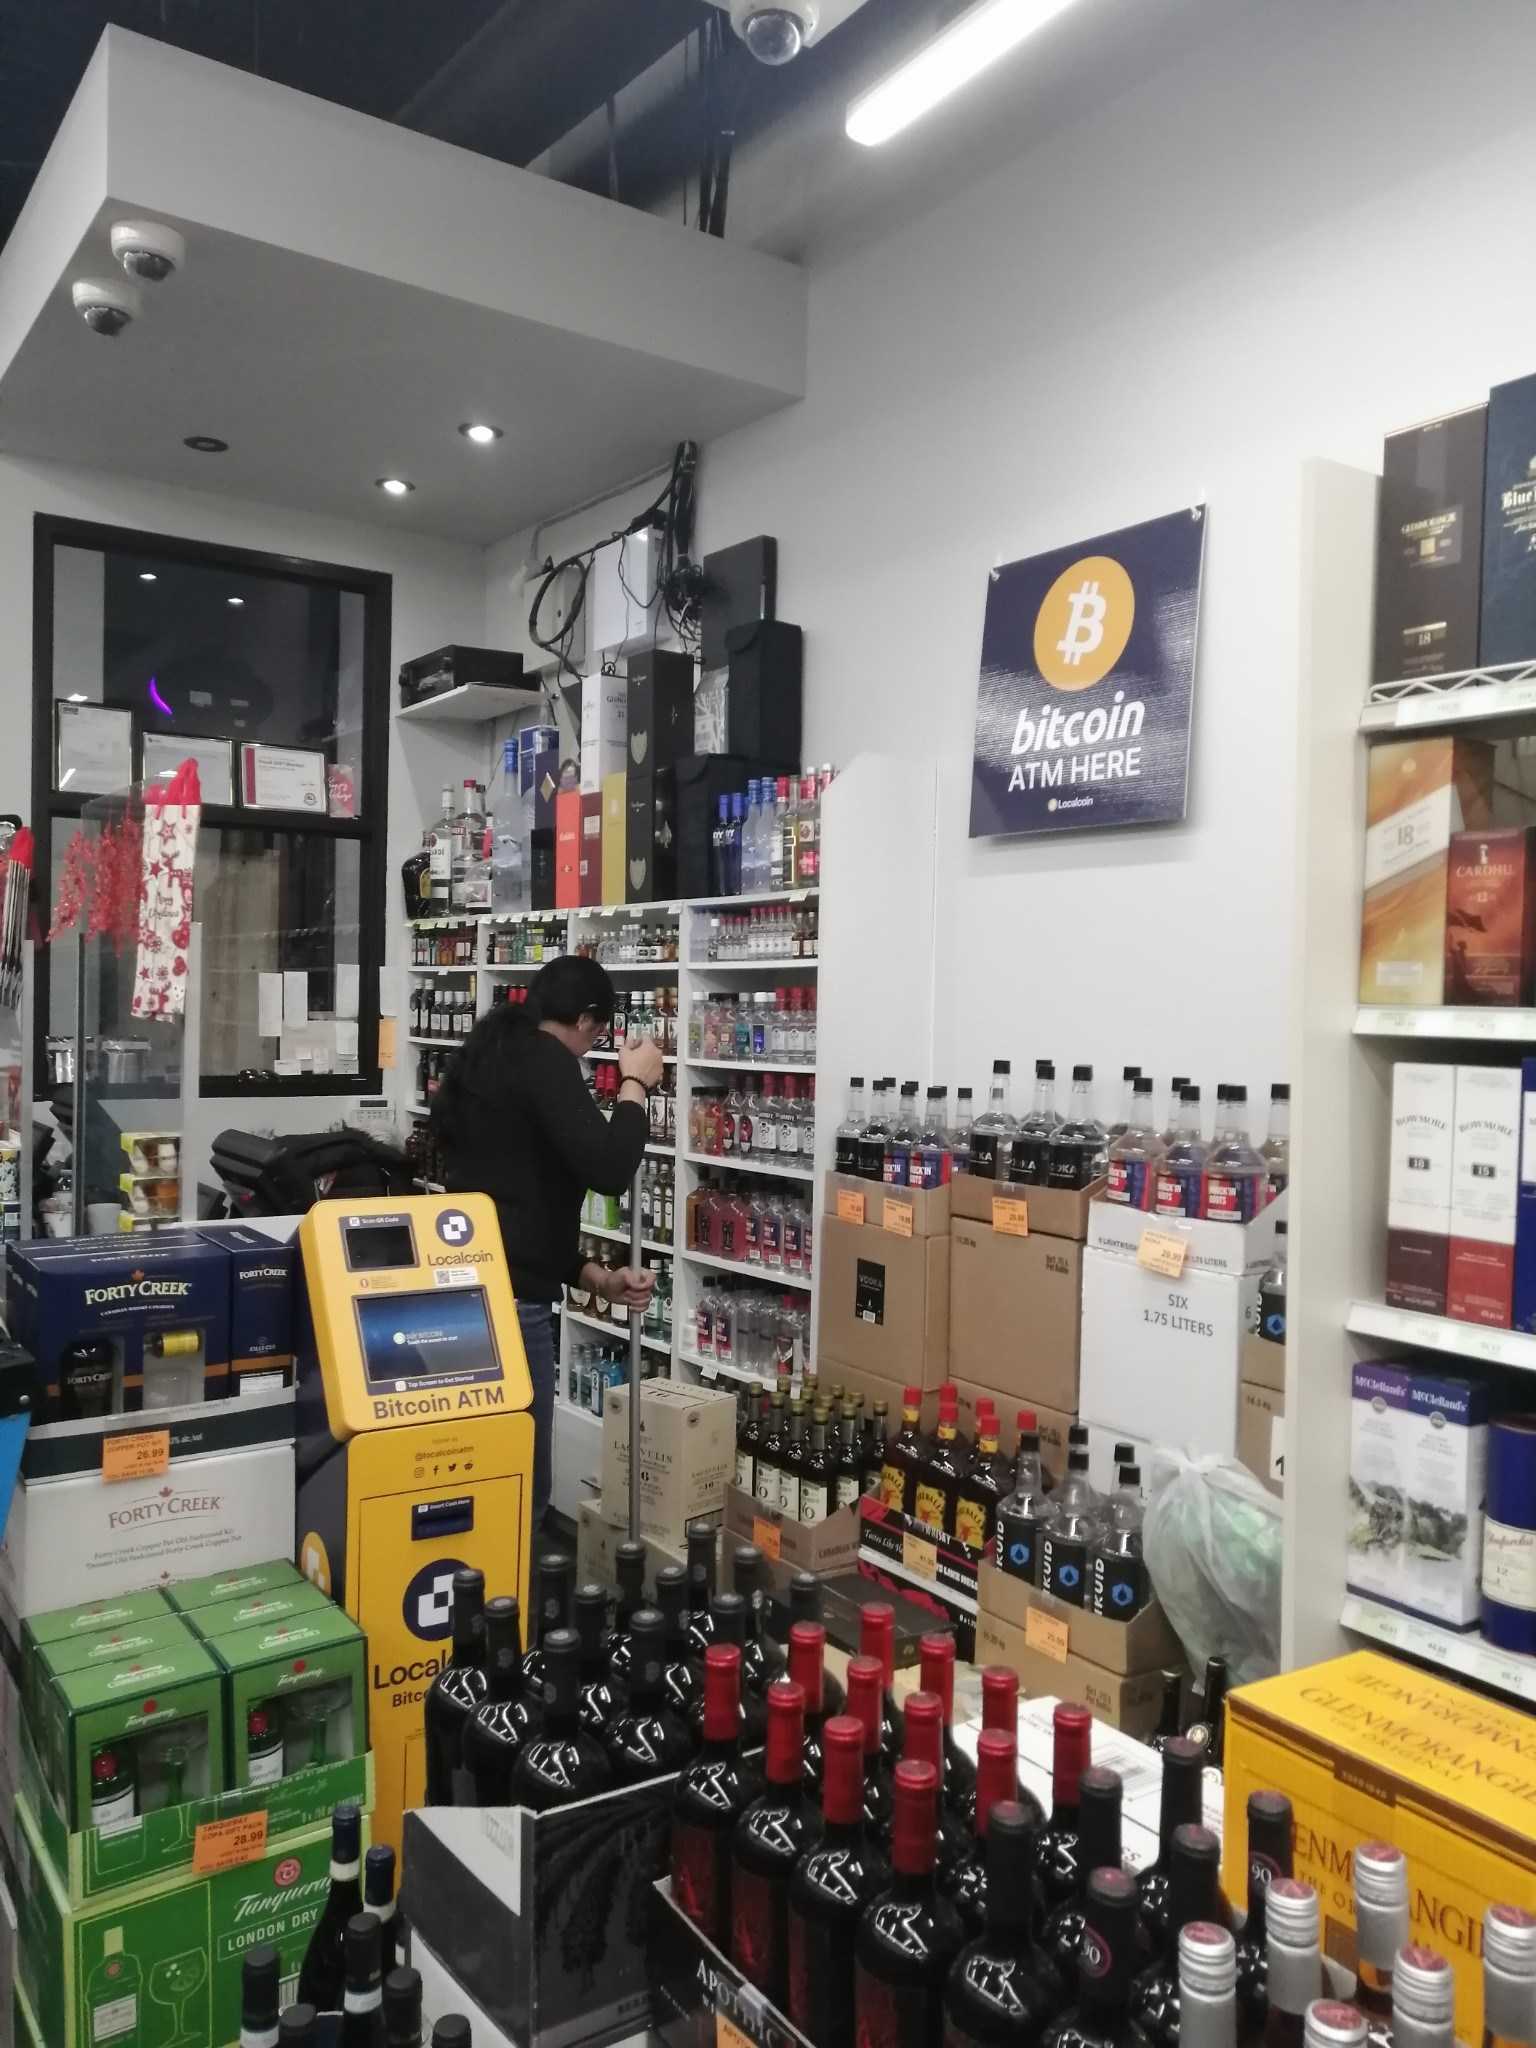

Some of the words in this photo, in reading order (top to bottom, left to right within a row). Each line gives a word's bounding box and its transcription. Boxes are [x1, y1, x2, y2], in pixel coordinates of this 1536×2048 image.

[1011, 690, 1146, 756] bitcoin
[1007, 757, 1064, 793] ATM
[1070, 747, 1142, 785] HERE
[1396, 825, 1414, 846] 18
[1396, 1114, 1447, 1131] BOWMORE
[1459, 1120, 1513, 1137] BOWMORE
[427, 1251, 494, 1267] Localcoin
[239, 1269, 263, 1280] FORTY
[85, 1282, 139, 1305] FORTY
[139, 1281, 188, 1296] CREEK
[1167, 1294, 1189, 1310] SIX
[1143, 1309, 1168, 1326] 1.75
[1170, 1315, 1214, 1337] LITERS
[408, 1381, 419, 1389] Tap
[419, 1380, 438, 1388] Screen
[455, 1375, 475, 1384] Started
[373, 1393, 451, 1420] Bitcoin
[457, 1386, 505, 1409] ATM
[108, 1499, 165, 1529] FORTY
[167, 1496, 221, 1514] CREEK
[996, 1520, 1004, 1570] KUID
[1043, 1540, 1053, 1595] IKUID
[1094, 1557, 1105, 1616] IKUID
[373, 1649, 452, 1690] Local
[233, 1830, 263, 1847] 28.99
[227, 1921, 286, 1951] LONDON
[291, 1906, 319, 1930] DRY
